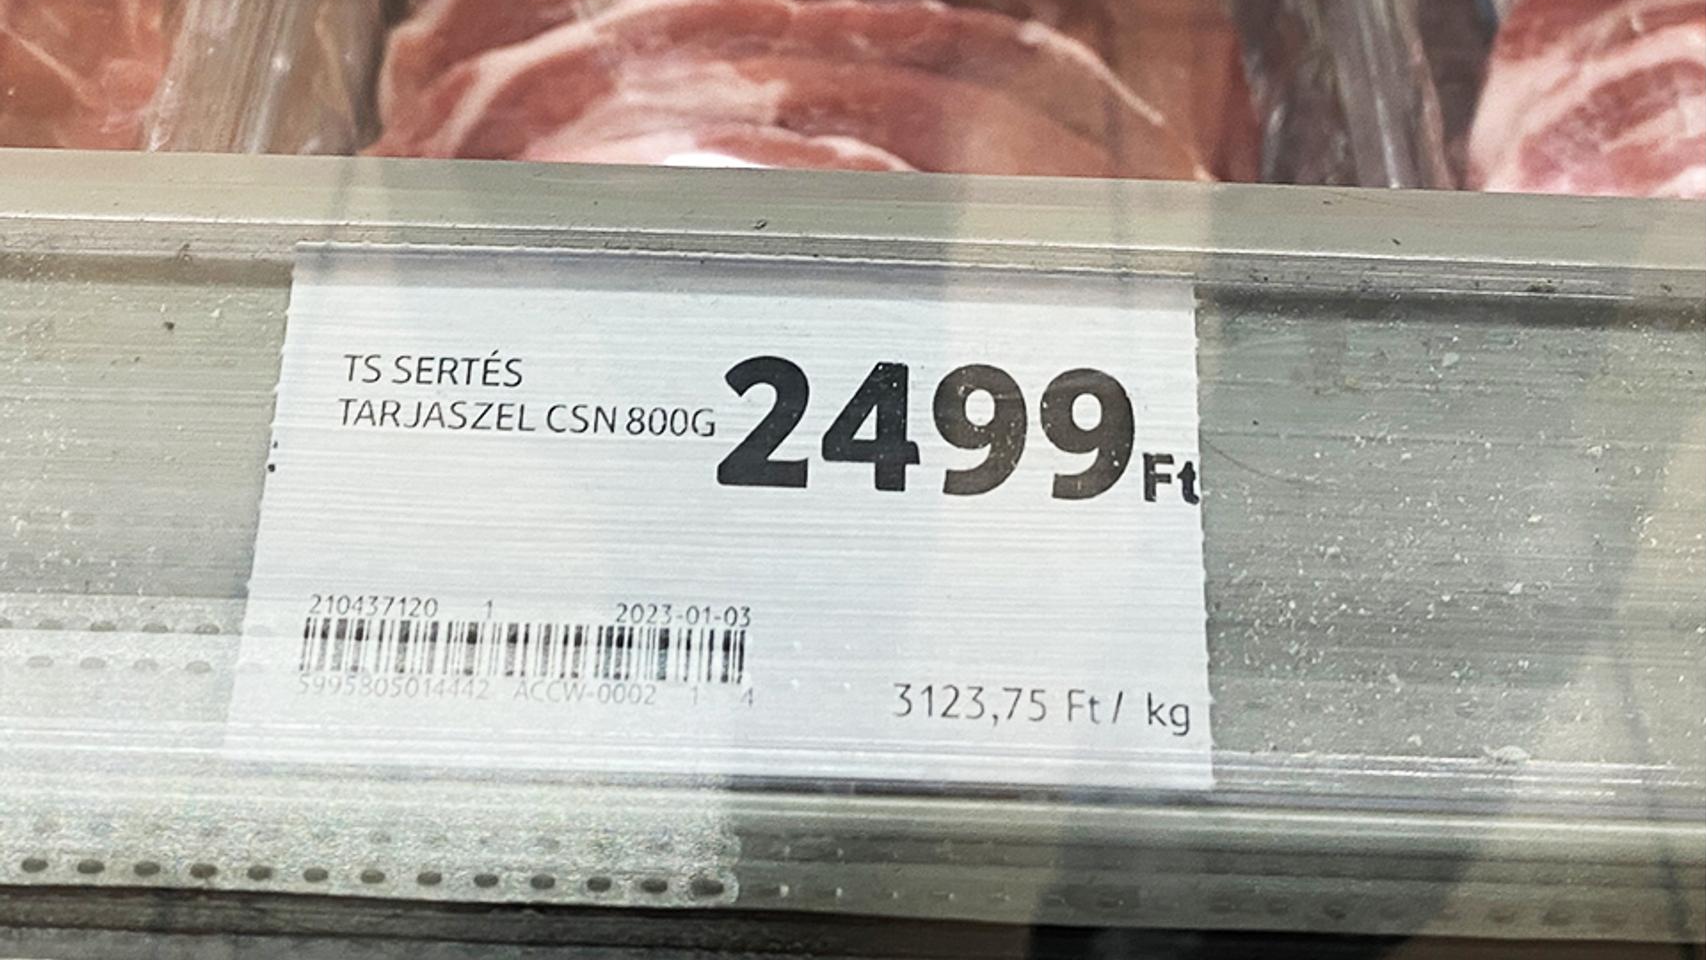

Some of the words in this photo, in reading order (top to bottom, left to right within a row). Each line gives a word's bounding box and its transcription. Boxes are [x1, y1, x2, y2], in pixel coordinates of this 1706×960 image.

[344, 354, 382, 384] TS
[392, 349, 523, 388] SERTÉS
[338, 398, 536, 433] TARJASZEL
[546, 403, 617, 435] CSN
[625, 406, 717, 438] 800G
[717, 355, 1136, 500] 2499
[1142, 452, 1200, 506] Ft
[307, 594, 440, 618] 210437120
[485, 600, 494, 619] 1
[616, 603, 752, 627] 2023-01-03
[299, 675, 490, 701] 5995805014442
[513, 681, 658, 706] ACCW-0002
[691, 686, 699, 705] 1
[740, 685, 755, 707] 4
[894, 683, 1047, 727] 3123,75
[1147, 691, 1191, 737] kg
